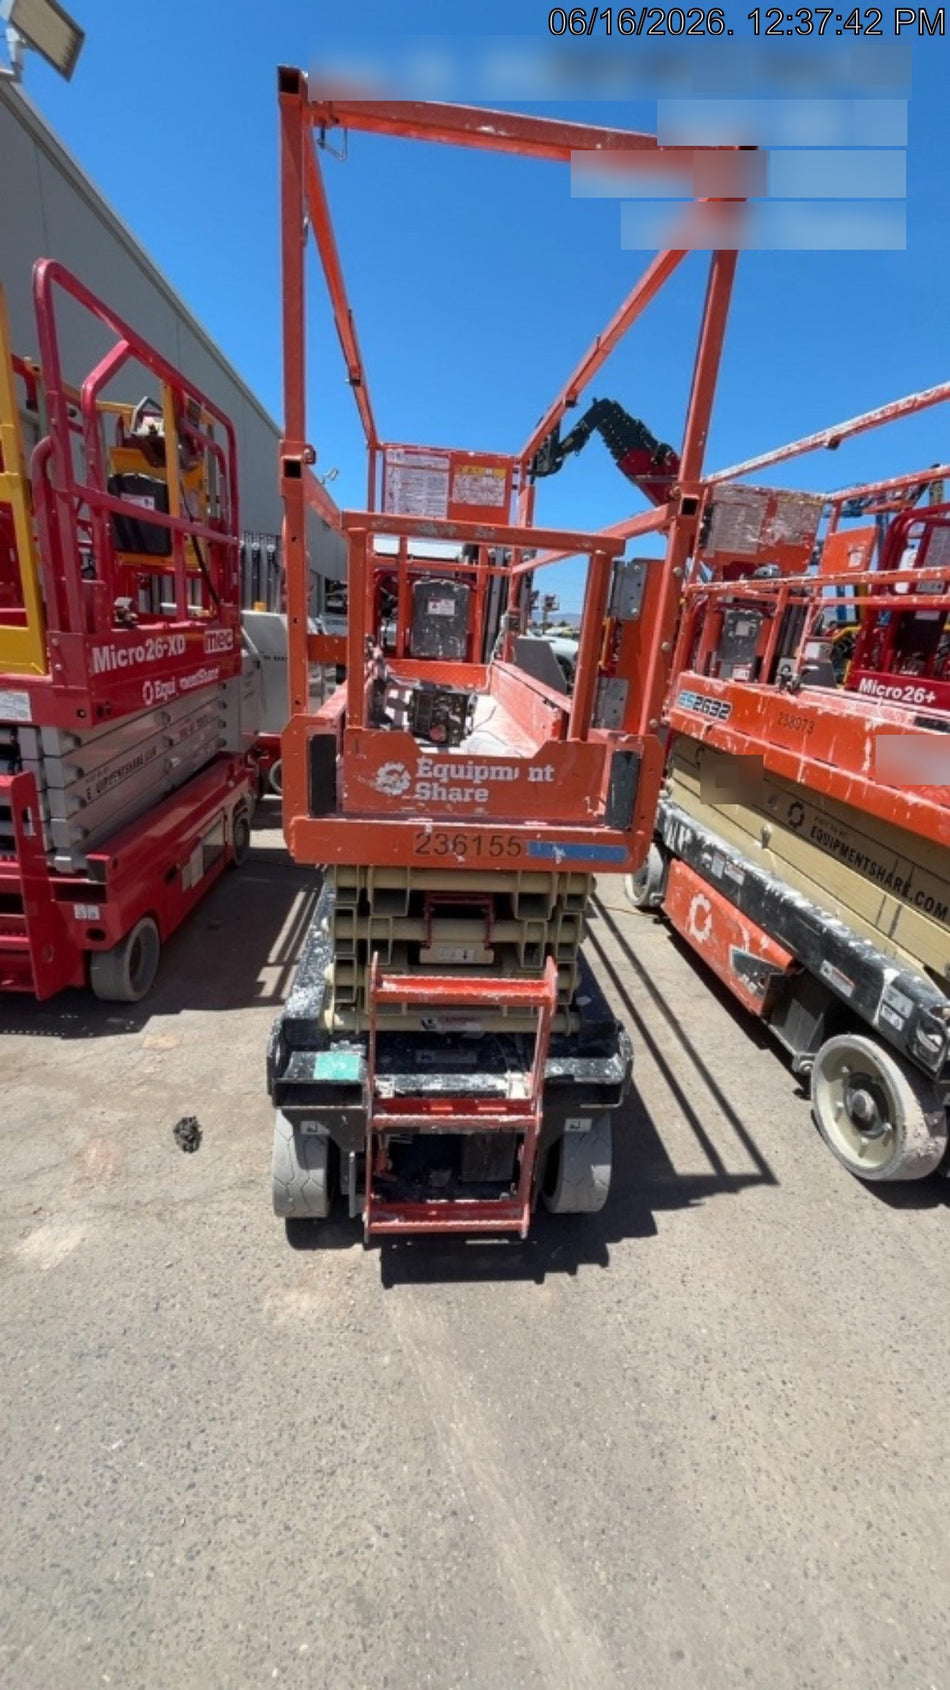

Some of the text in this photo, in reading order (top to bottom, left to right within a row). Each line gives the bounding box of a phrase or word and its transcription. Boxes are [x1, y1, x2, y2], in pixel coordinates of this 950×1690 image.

[92, 634, 186, 673] Micro26-XD
[204, 628, 233, 654] mec
[858, 677, 937, 704] Micro26+
[677, 690, 732, 721] ES2632
[416, 755, 556, 784] Equipmnt
[416, 781, 490, 803] Share
[414, 832, 523, 858] 236155
[809, 824, 950, 922] EQUIPMENTSHARE.COM
